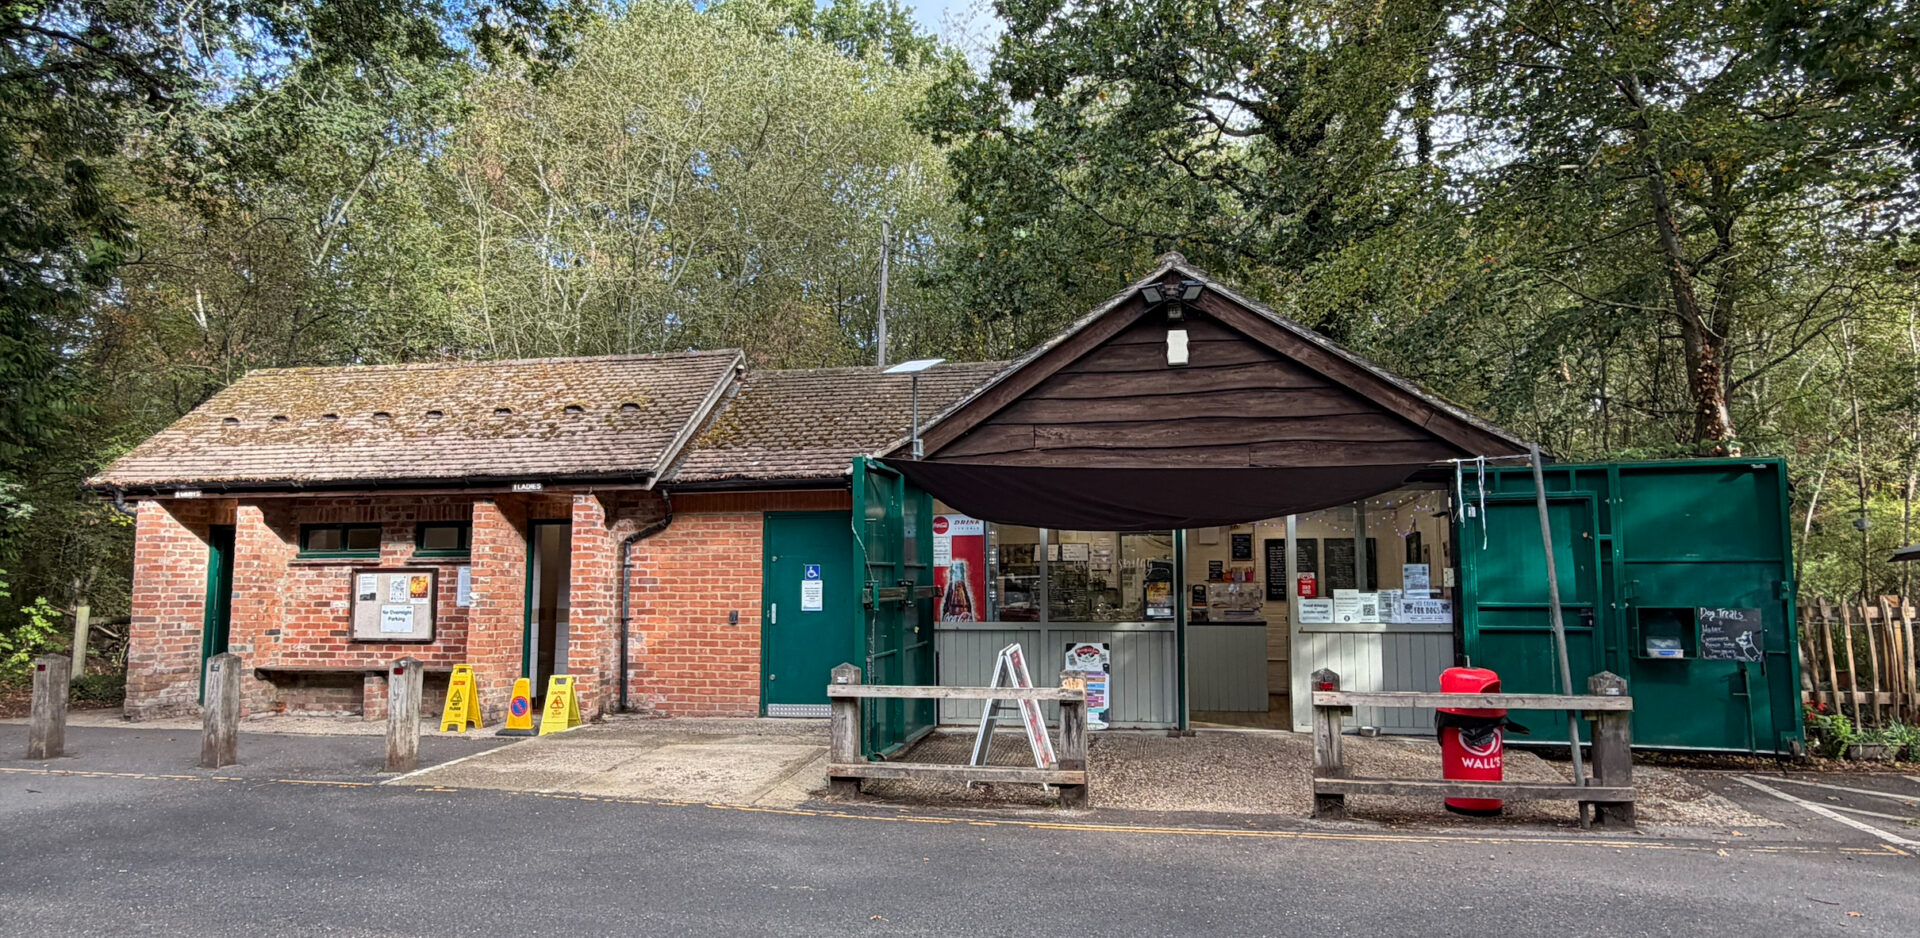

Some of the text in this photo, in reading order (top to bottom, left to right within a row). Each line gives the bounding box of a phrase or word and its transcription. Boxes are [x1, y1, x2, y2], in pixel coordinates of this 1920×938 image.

[1700, 607, 1744, 621] Dog Treats
[1462, 756, 1502, 769] WALL'S
